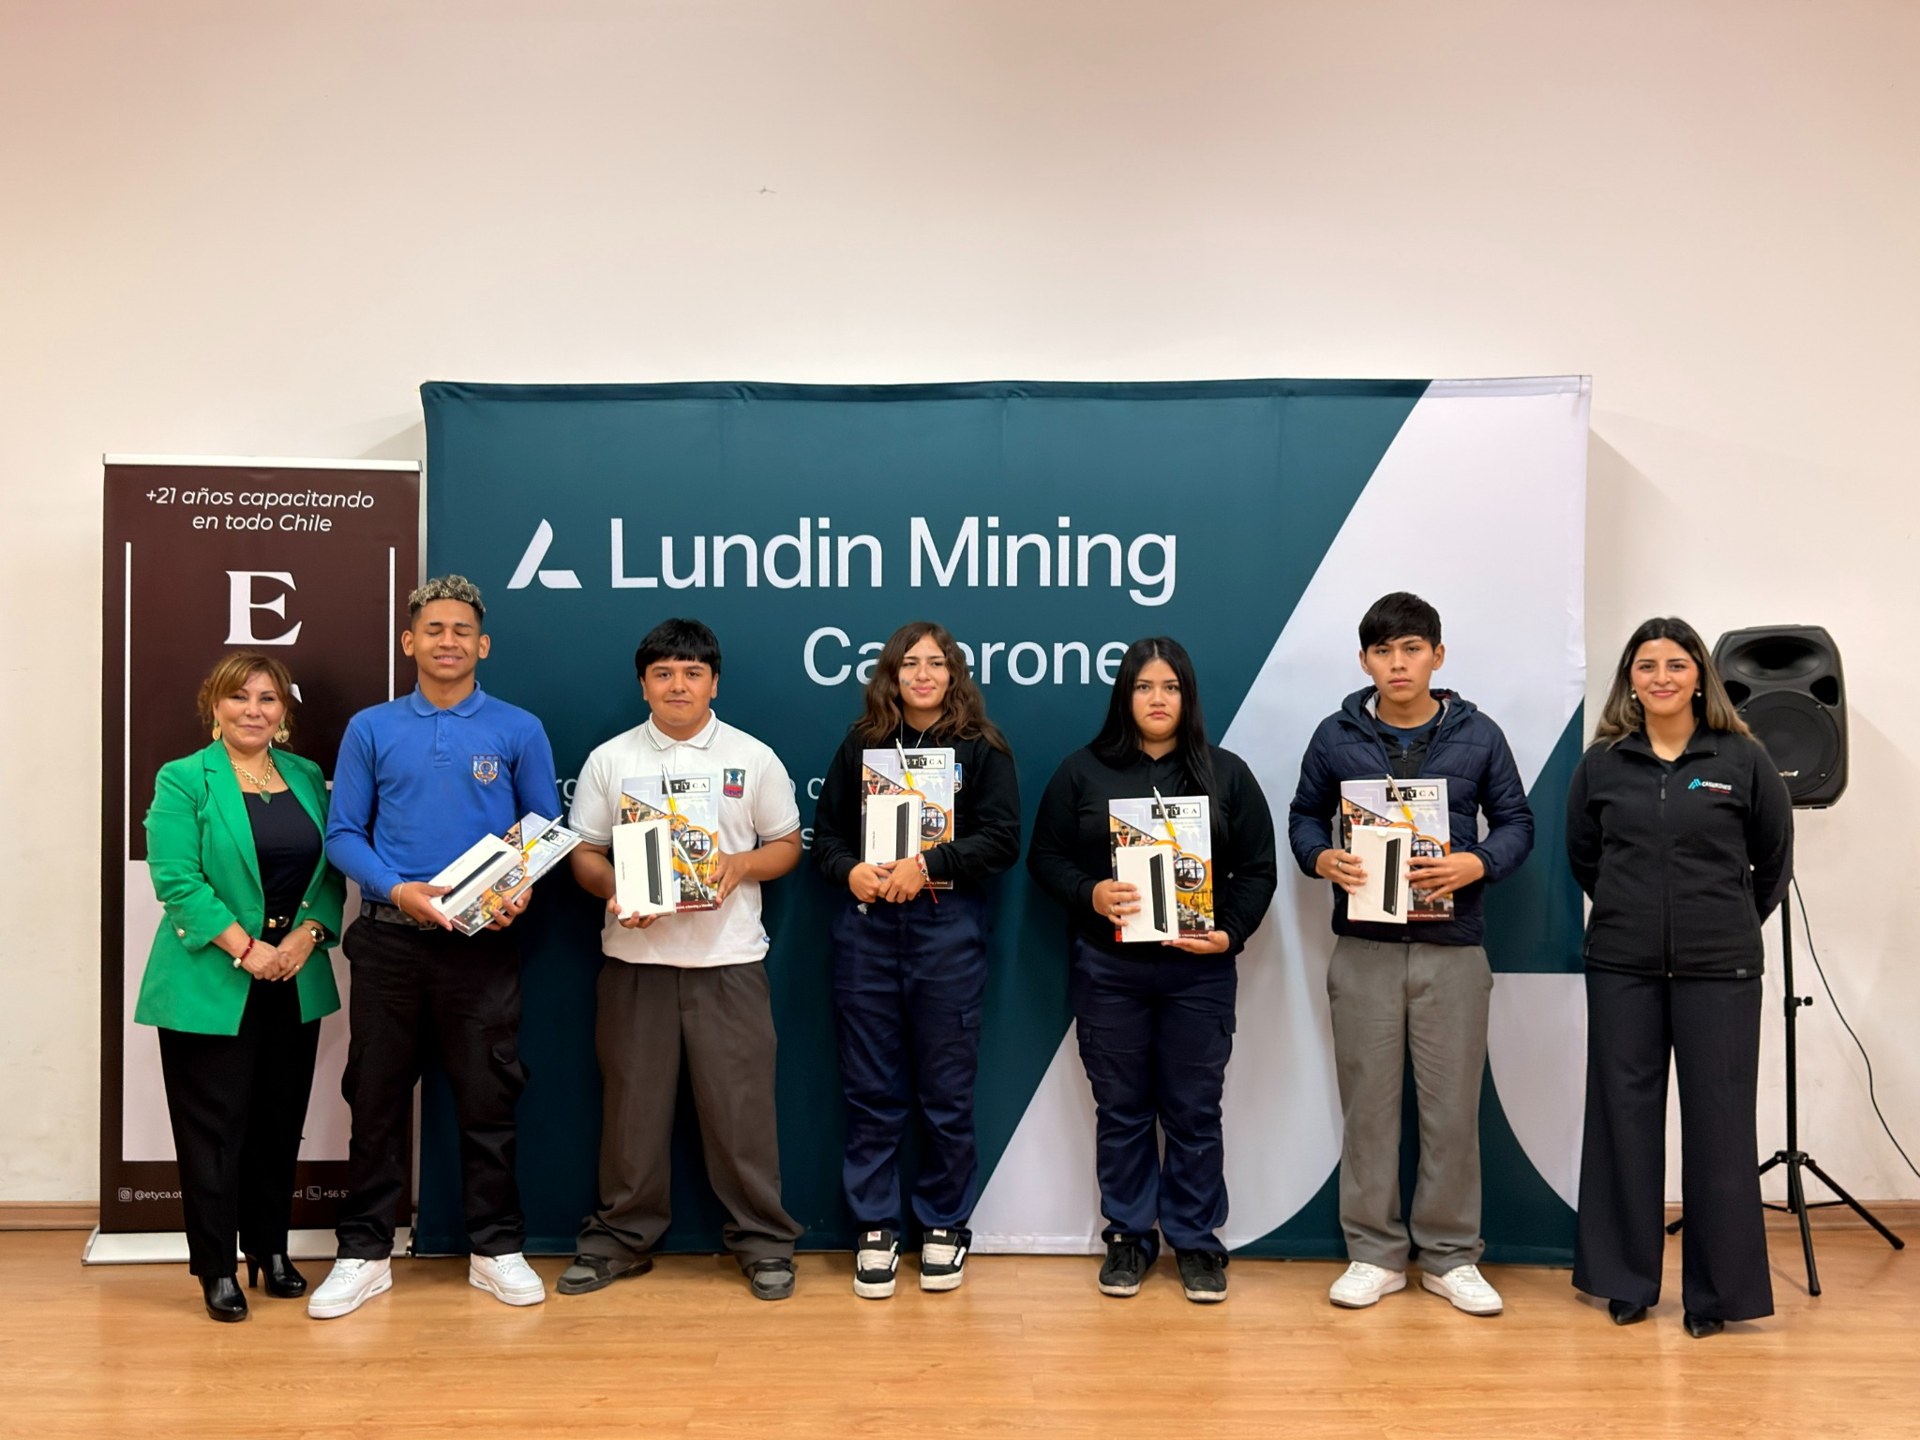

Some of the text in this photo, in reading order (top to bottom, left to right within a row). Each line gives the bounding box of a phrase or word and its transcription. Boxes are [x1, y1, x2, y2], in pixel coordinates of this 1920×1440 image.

[146, 487, 375, 510] +21 años capacitando
[192, 512, 333, 532] en todo Chile
[610, 516, 1177, 607] Lundin Mining
